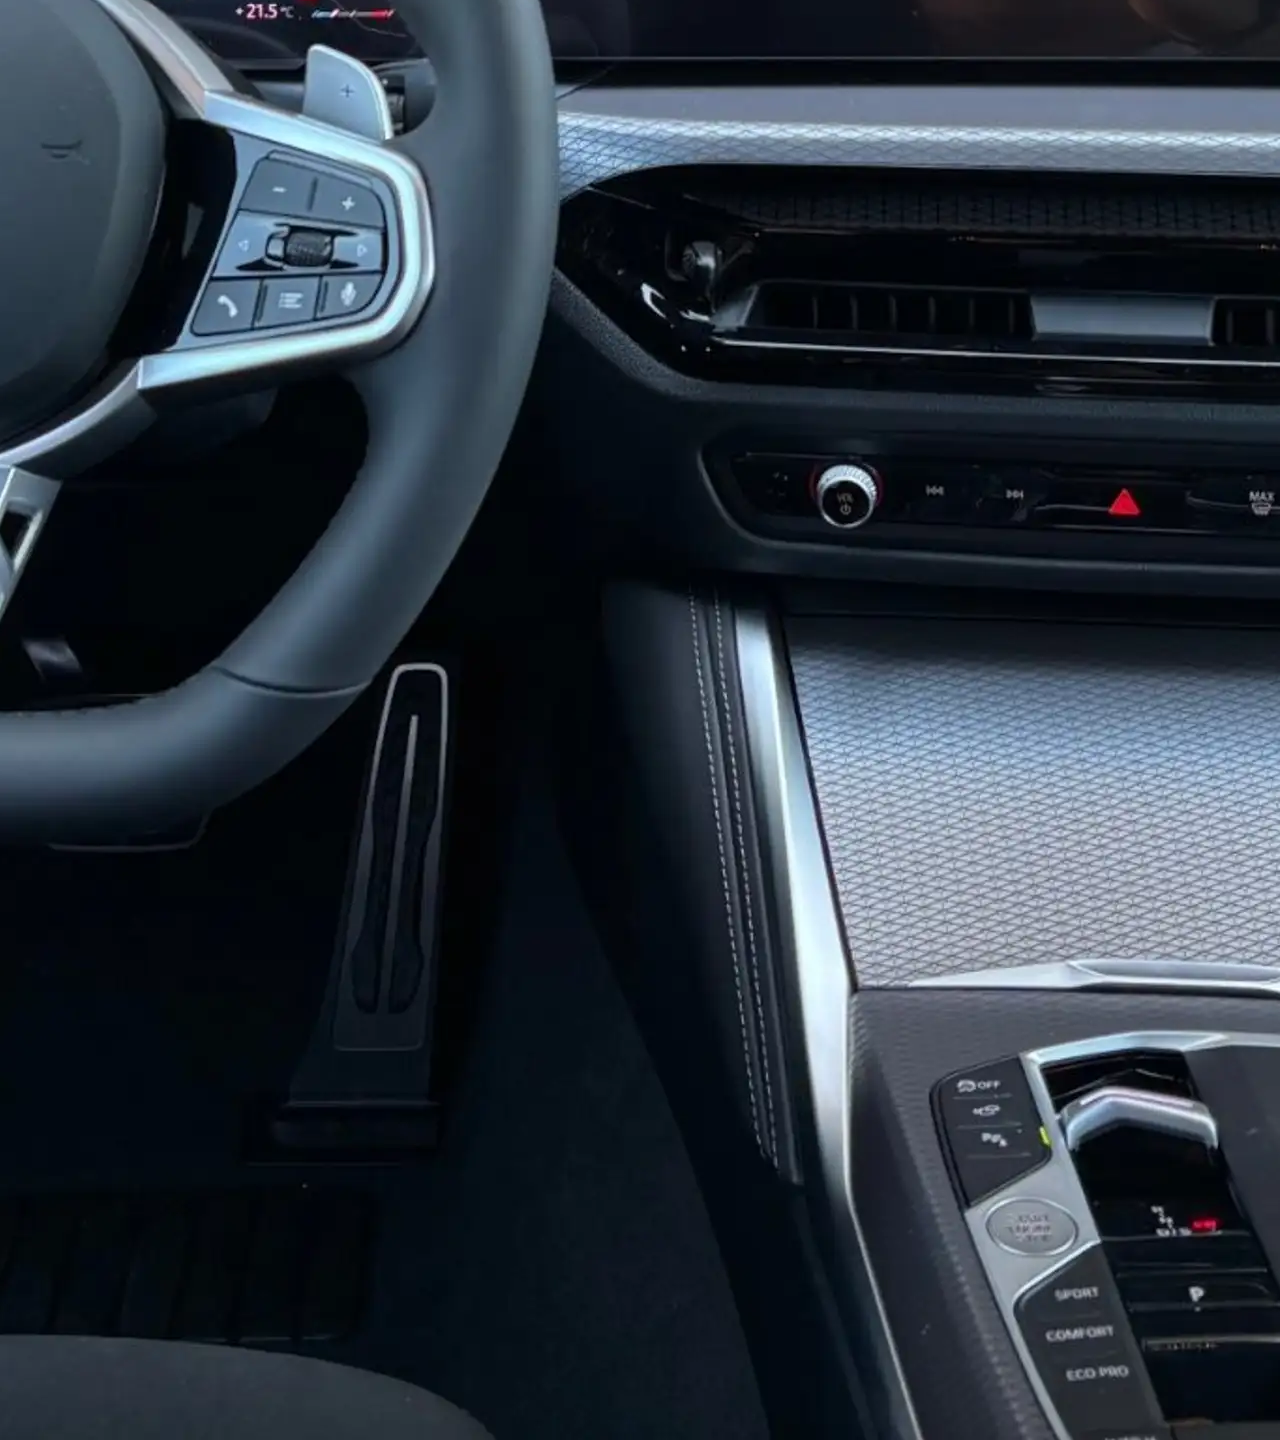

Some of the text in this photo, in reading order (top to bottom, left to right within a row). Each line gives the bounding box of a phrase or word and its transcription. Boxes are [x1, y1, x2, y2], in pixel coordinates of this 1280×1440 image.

[1249, 491, 1276, 502] MAX
[977, 1079, 1001, 1090] OFF
[1054, 1287, 1100, 1302] SPORT
[1188, 1286, 1205, 1302] P
[1045, 1325, 1115, 1342] COMFORT
[1066, 1365, 1130, 1381] ECO PRO
